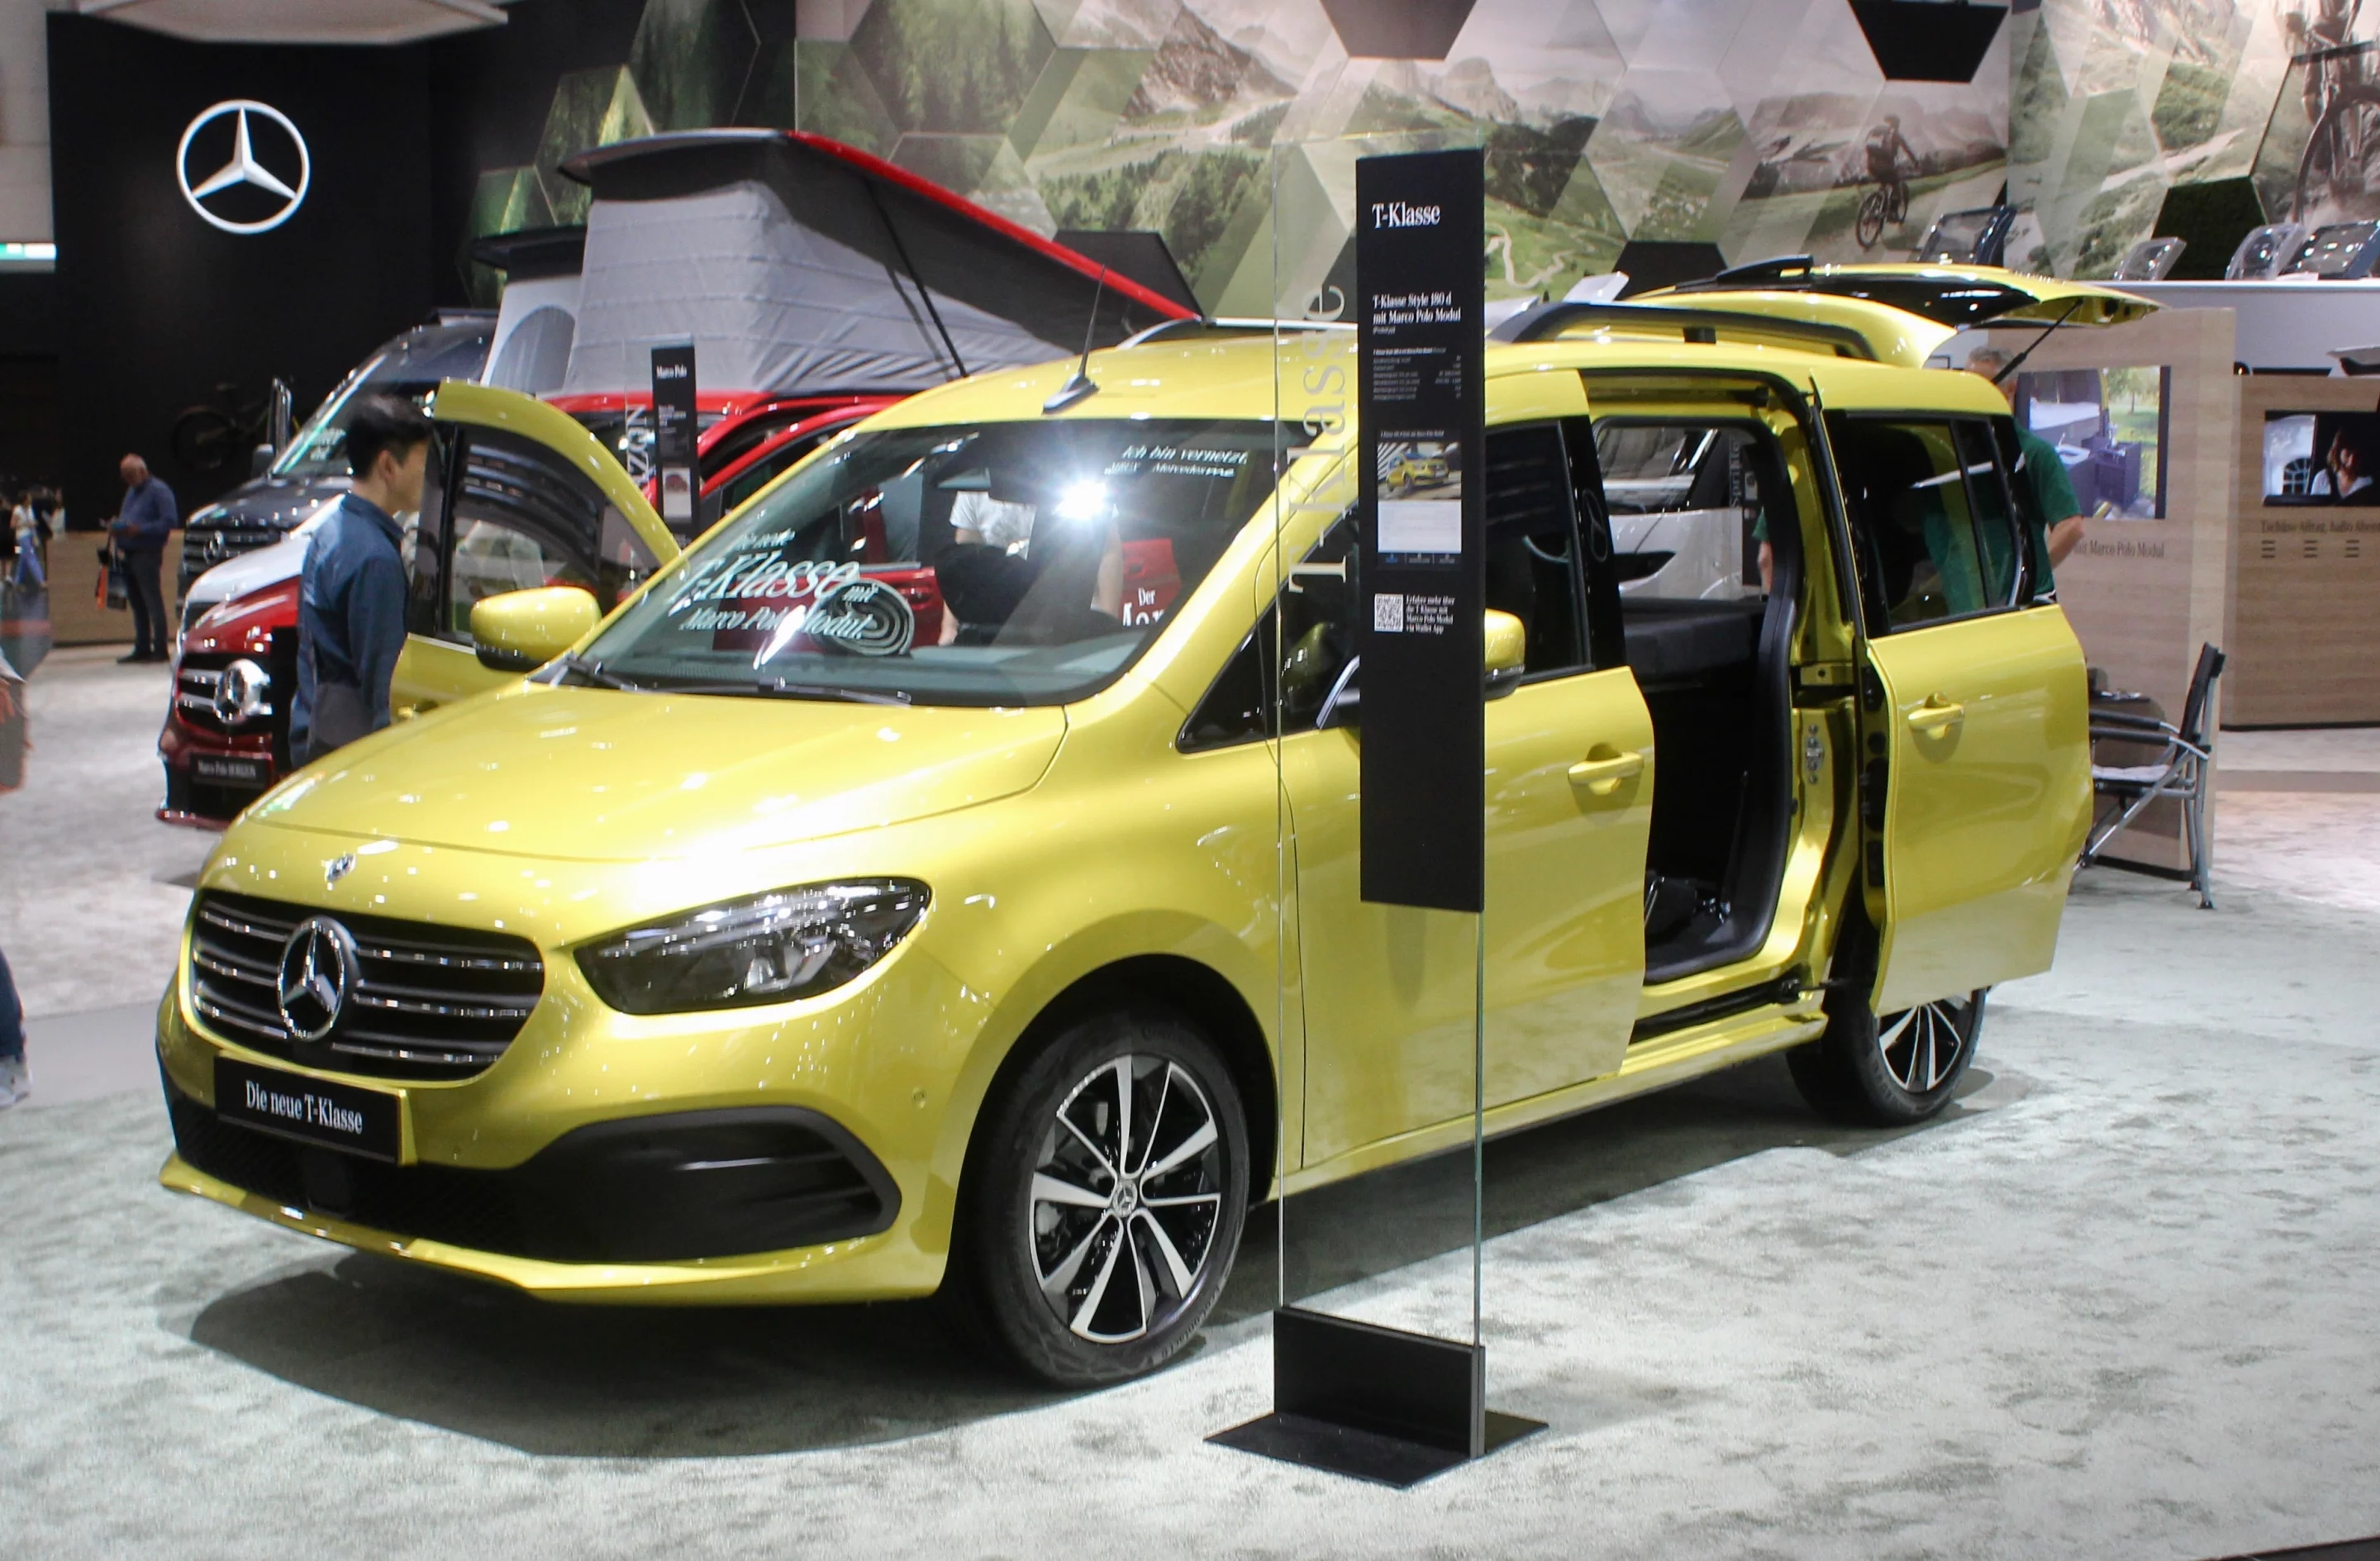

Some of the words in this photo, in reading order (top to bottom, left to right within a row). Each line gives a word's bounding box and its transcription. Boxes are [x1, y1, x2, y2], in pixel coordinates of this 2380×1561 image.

[1372, 202, 1440, 228] T-Klasse
[1372, 293, 1407, 309] T-Klasse
[1407, 293, 1429, 309] Style
[1430, 291, 1445, 307] 180
[1445, 291, 1452, 306] d
[1373, 311, 1387, 325] mit
[1389, 309, 1414, 324] Marco
[1416, 308, 1434, 323] Polo
[1435, 307, 1461, 322] Modul
[1287, 285, 1346, 593] T-Klasse
[1150, 445, 1177, 460] bin
[2090, 540, 2116, 557] Marco
[2117, 540, 2135, 558] Polo
[2137, 541, 2164, 559] Modul
[670, 550, 860, 601] T-Klasse
[1138, 588, 1155, 607] Der
[678, 607, 745, 631] Marco
[742, 606, 793, 631] Pol
[246, 1080, 268, 1112] Die
[270, 1091, 302, 1120] neue
[304, 1093, 363, 1135] T-Klasse
